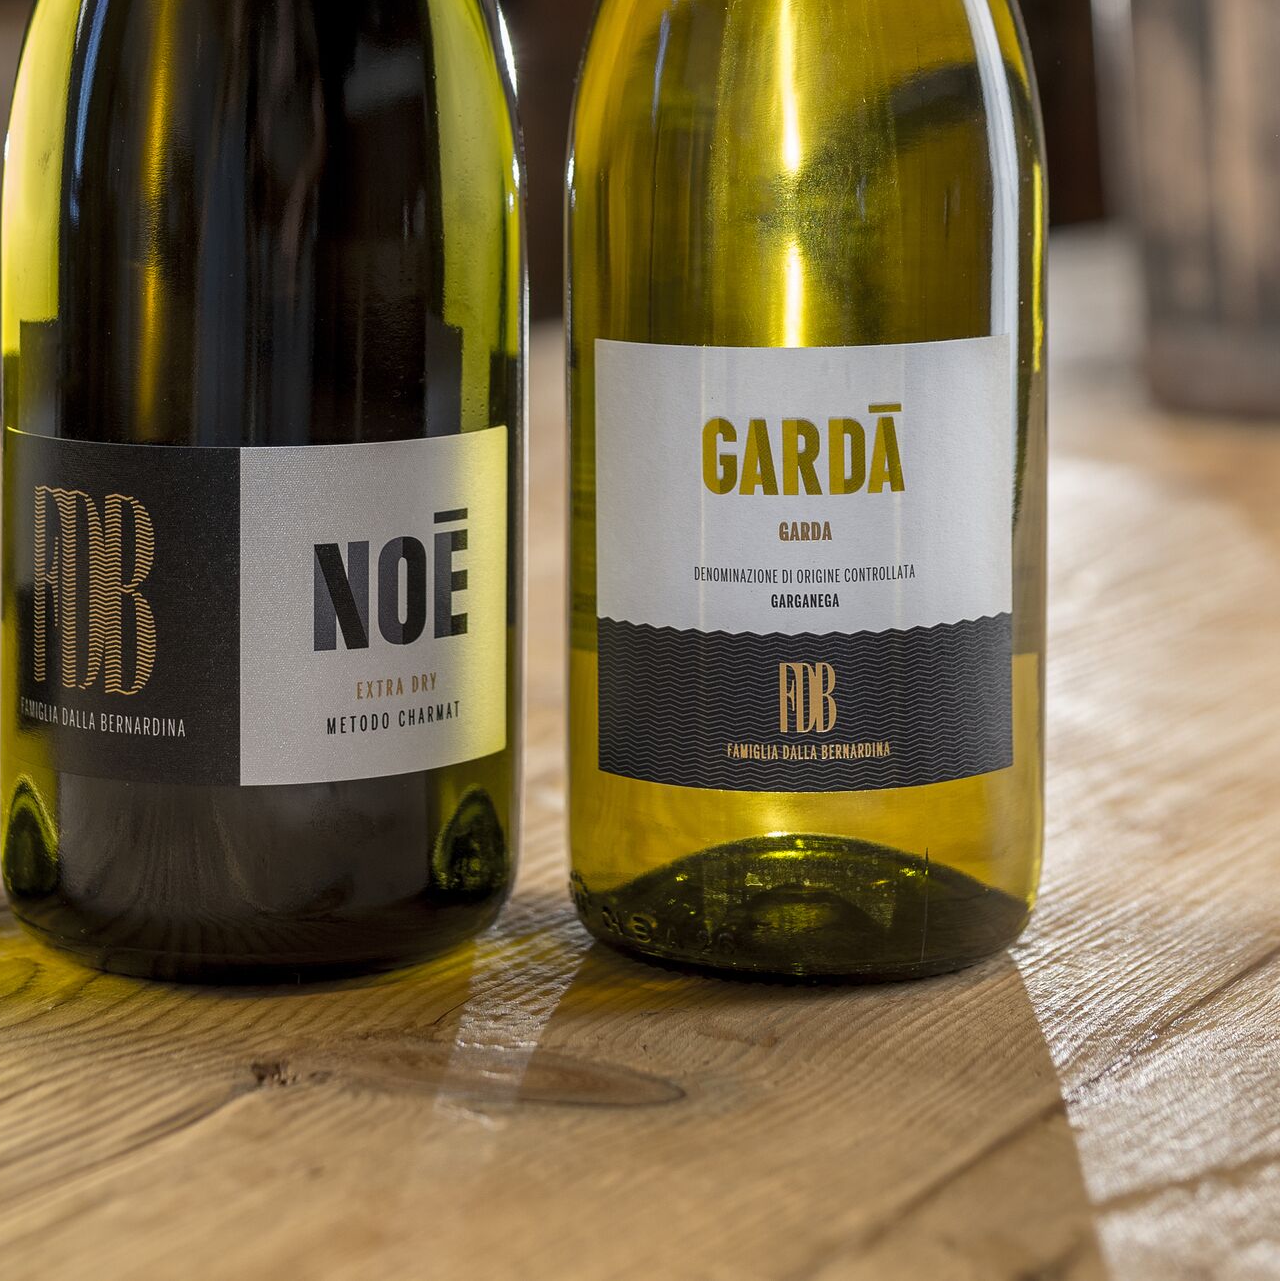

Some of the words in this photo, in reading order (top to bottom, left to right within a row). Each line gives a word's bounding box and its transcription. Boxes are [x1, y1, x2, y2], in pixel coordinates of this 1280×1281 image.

[701, 402, 906, 497] GARDĀ
[778, 520, 833, 542] GARDA
[693, 565, 779, 585] DENOMINAZIONE
[781, 567, 793, 585] DI
[796, 566, 841, 585] ORIGINE
[843, 563, 917, 583] CONTROLLATA
[33, 485, 158, 696] FDB
[770, 592, 841, 609] GARGANEGA
[356, 676, 405, 701] EXTRA
[411, 672, 438, 695] DRY
[778, 661, 838, 734] FDB
[20, 695, 59, 725] FAMIGLIA
[62, 706, 96, 731] DALLA
[99, 712, 187, 738] BERNARDINA
[326, 709, 391, 736] METODO
[398, 700, 462, 728] CHARMAT
[726, 742, 779, 761] FAMIGLIA
[782, 743, 818, 761] DALLA
[820, 740, 891, 761] BERNARDINA
